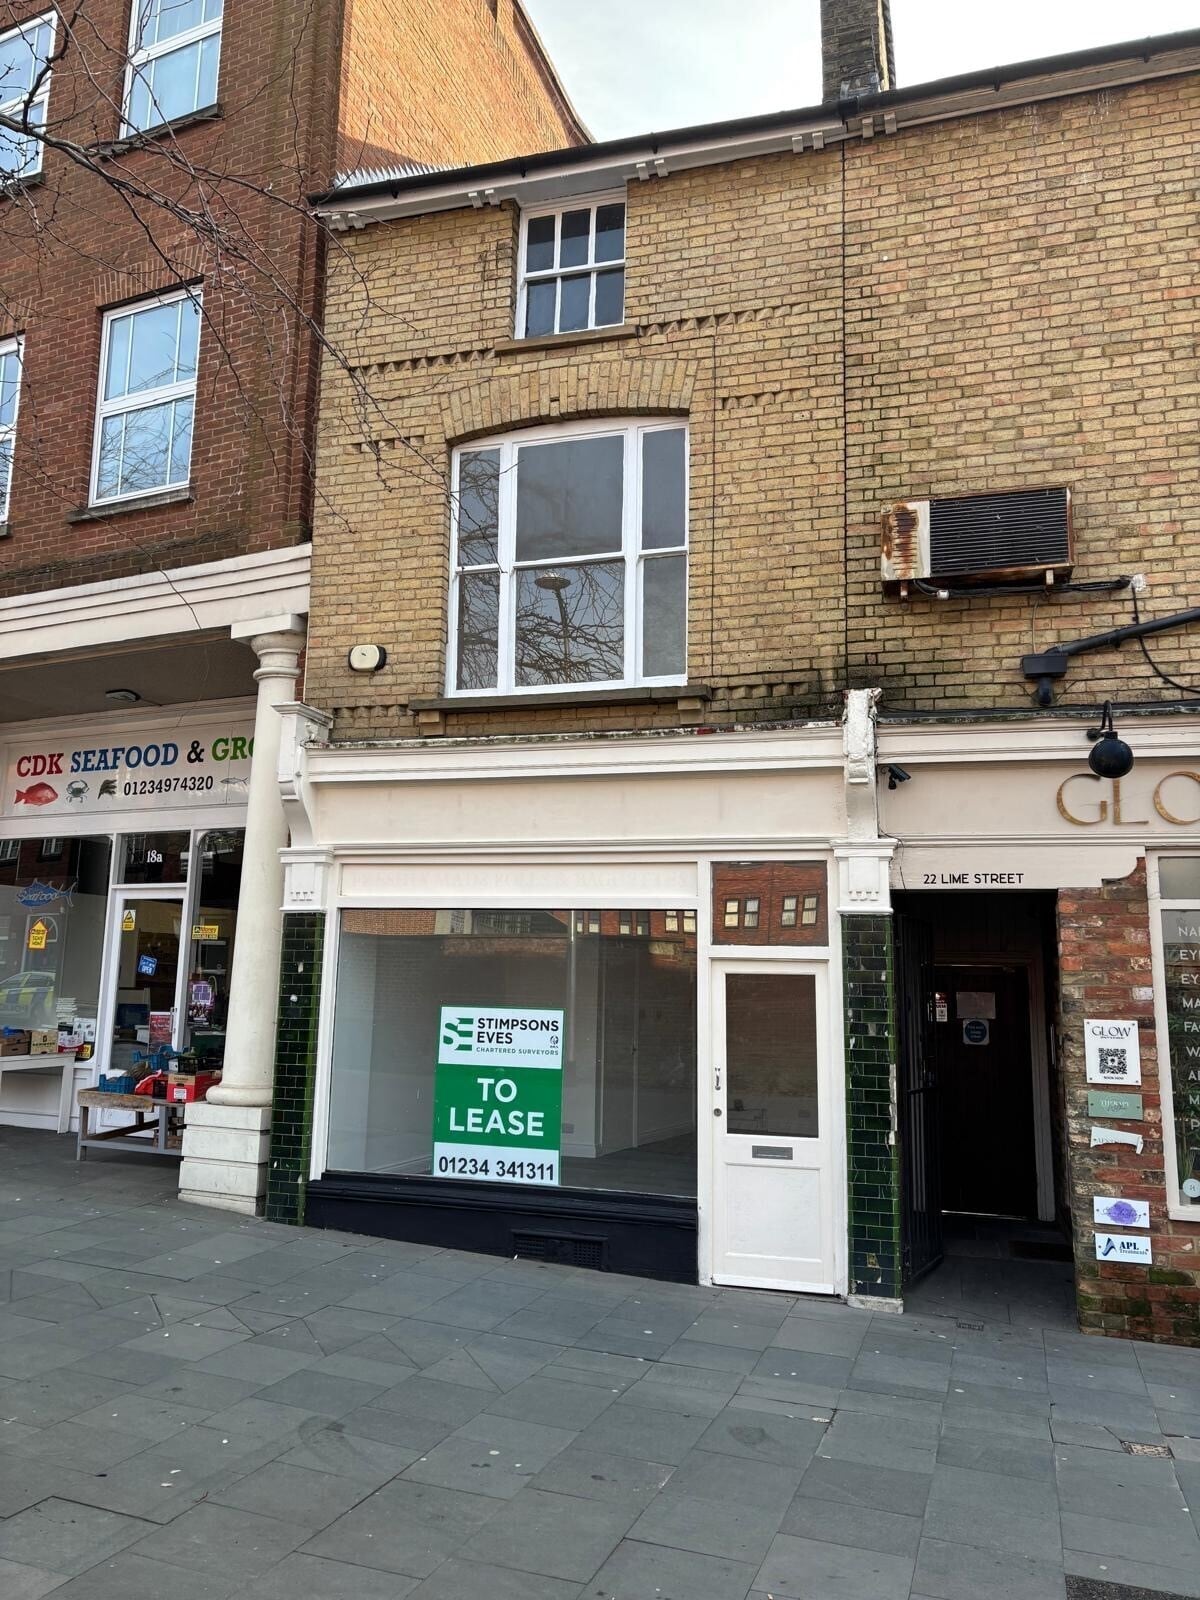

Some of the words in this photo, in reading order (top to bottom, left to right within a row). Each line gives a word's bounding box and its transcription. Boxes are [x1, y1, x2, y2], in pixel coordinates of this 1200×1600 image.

[16, 752, 64, 777] CDK
[70, 742, 178, 773] SEAFOOD
[187, 740, 205, 763] &
[123, 775, 213, 796] 01234974320
[146, 850, 163, 863] 18a
[923, 874, 937, 884] 22
[941, 873, 969, 884] LIME
[974, 873, 1024, 884] STREET
[477, 1018, 559, 1031] STIMPSONS
[1091, 1026, 1131, 1037] GLOW
[477, 1032, 513, 1044] EVES
[477, 1078, 517, 1103] TO
[450, 1107, 545, 1137] LEASE
[439, 1156, 490, 1176] 01234
[496, 1160, 554, 1181] 341311
